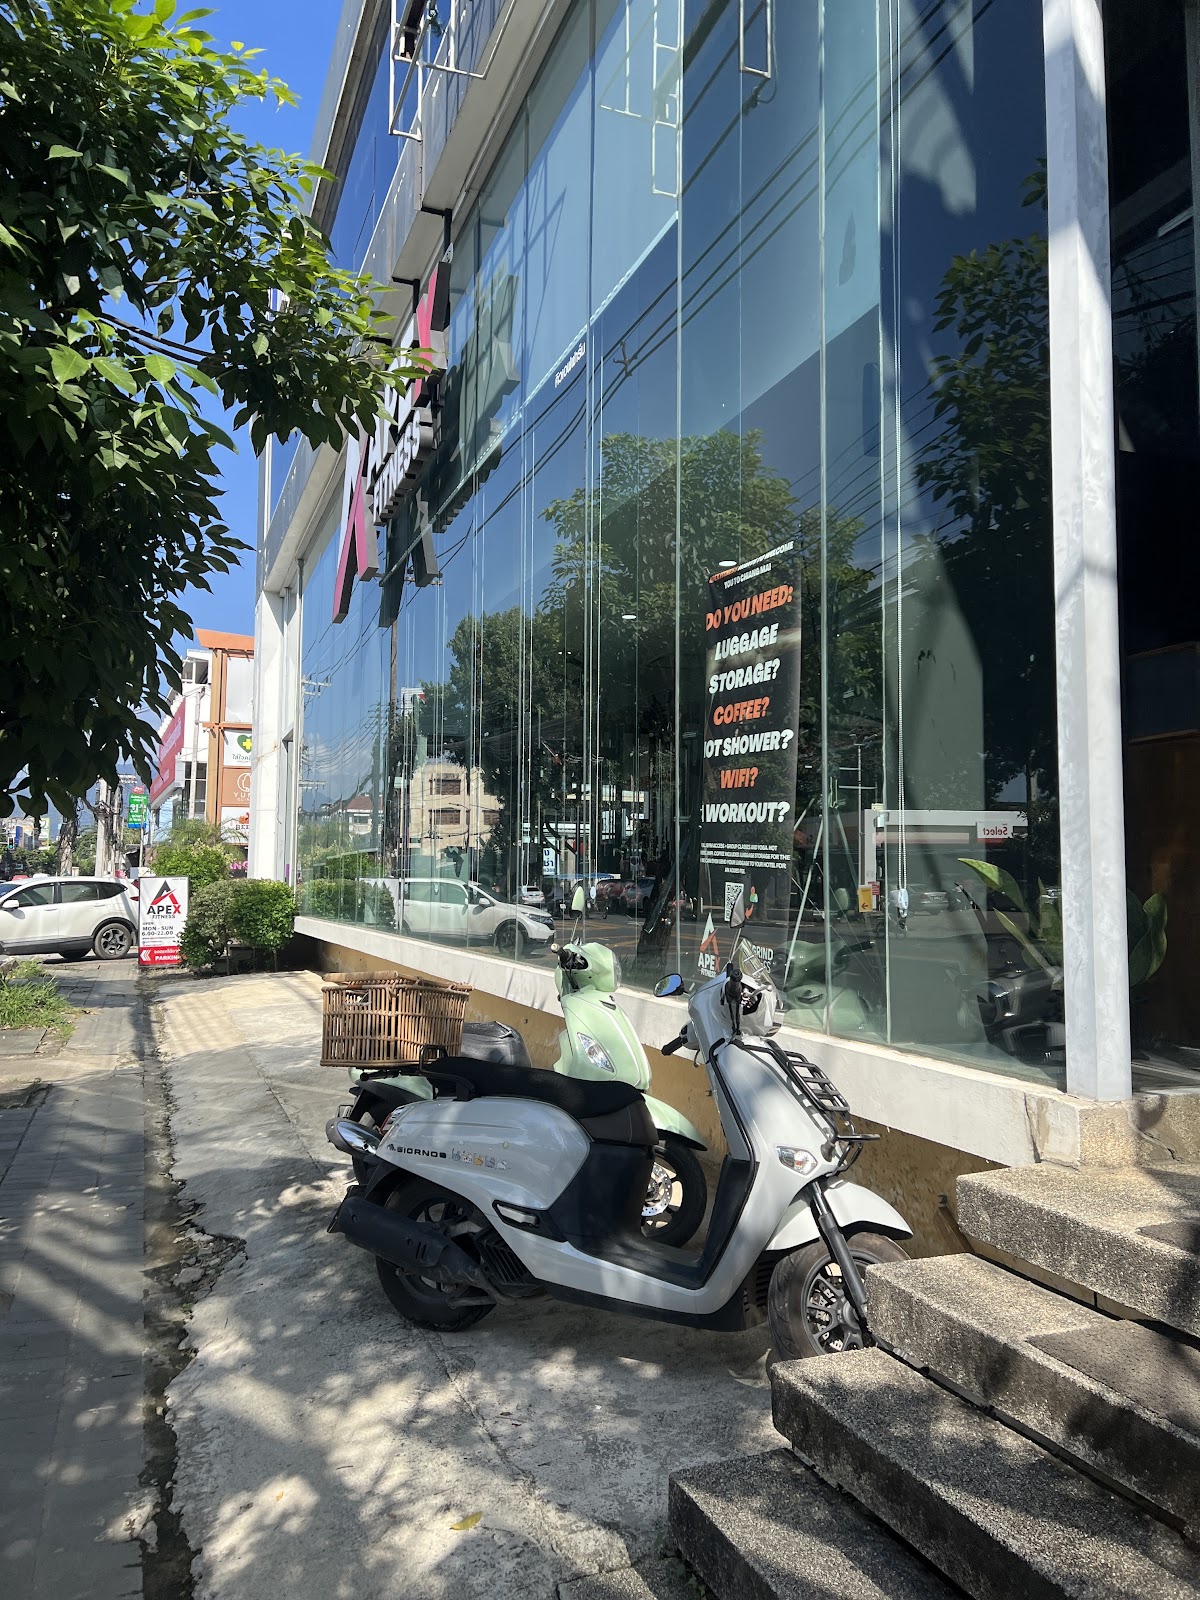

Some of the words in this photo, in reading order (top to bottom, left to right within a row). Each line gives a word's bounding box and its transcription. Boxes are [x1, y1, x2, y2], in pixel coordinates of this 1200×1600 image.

[373, 409, 421, 524] FITNESS
[706, 608, 722, 631] DO
[723, 599, 750, 625] YOU
[750, 584, 794, 616] NEED:
[714, 622, 779, 661] LUGGAGE
[708, 658, 781, 694] STORAGE?
[713, 696, 770, 726] COFFEE?
[704, 739, 723, 758] OT
[722, 729, 794, 757] SHOWER?
[720, 766, 759, 789] WIFI?
[706, 801, 791, 823] WORKOUT?
[147, 905, 181, 915] APEX
[698, 952, 720, 972] APEX
